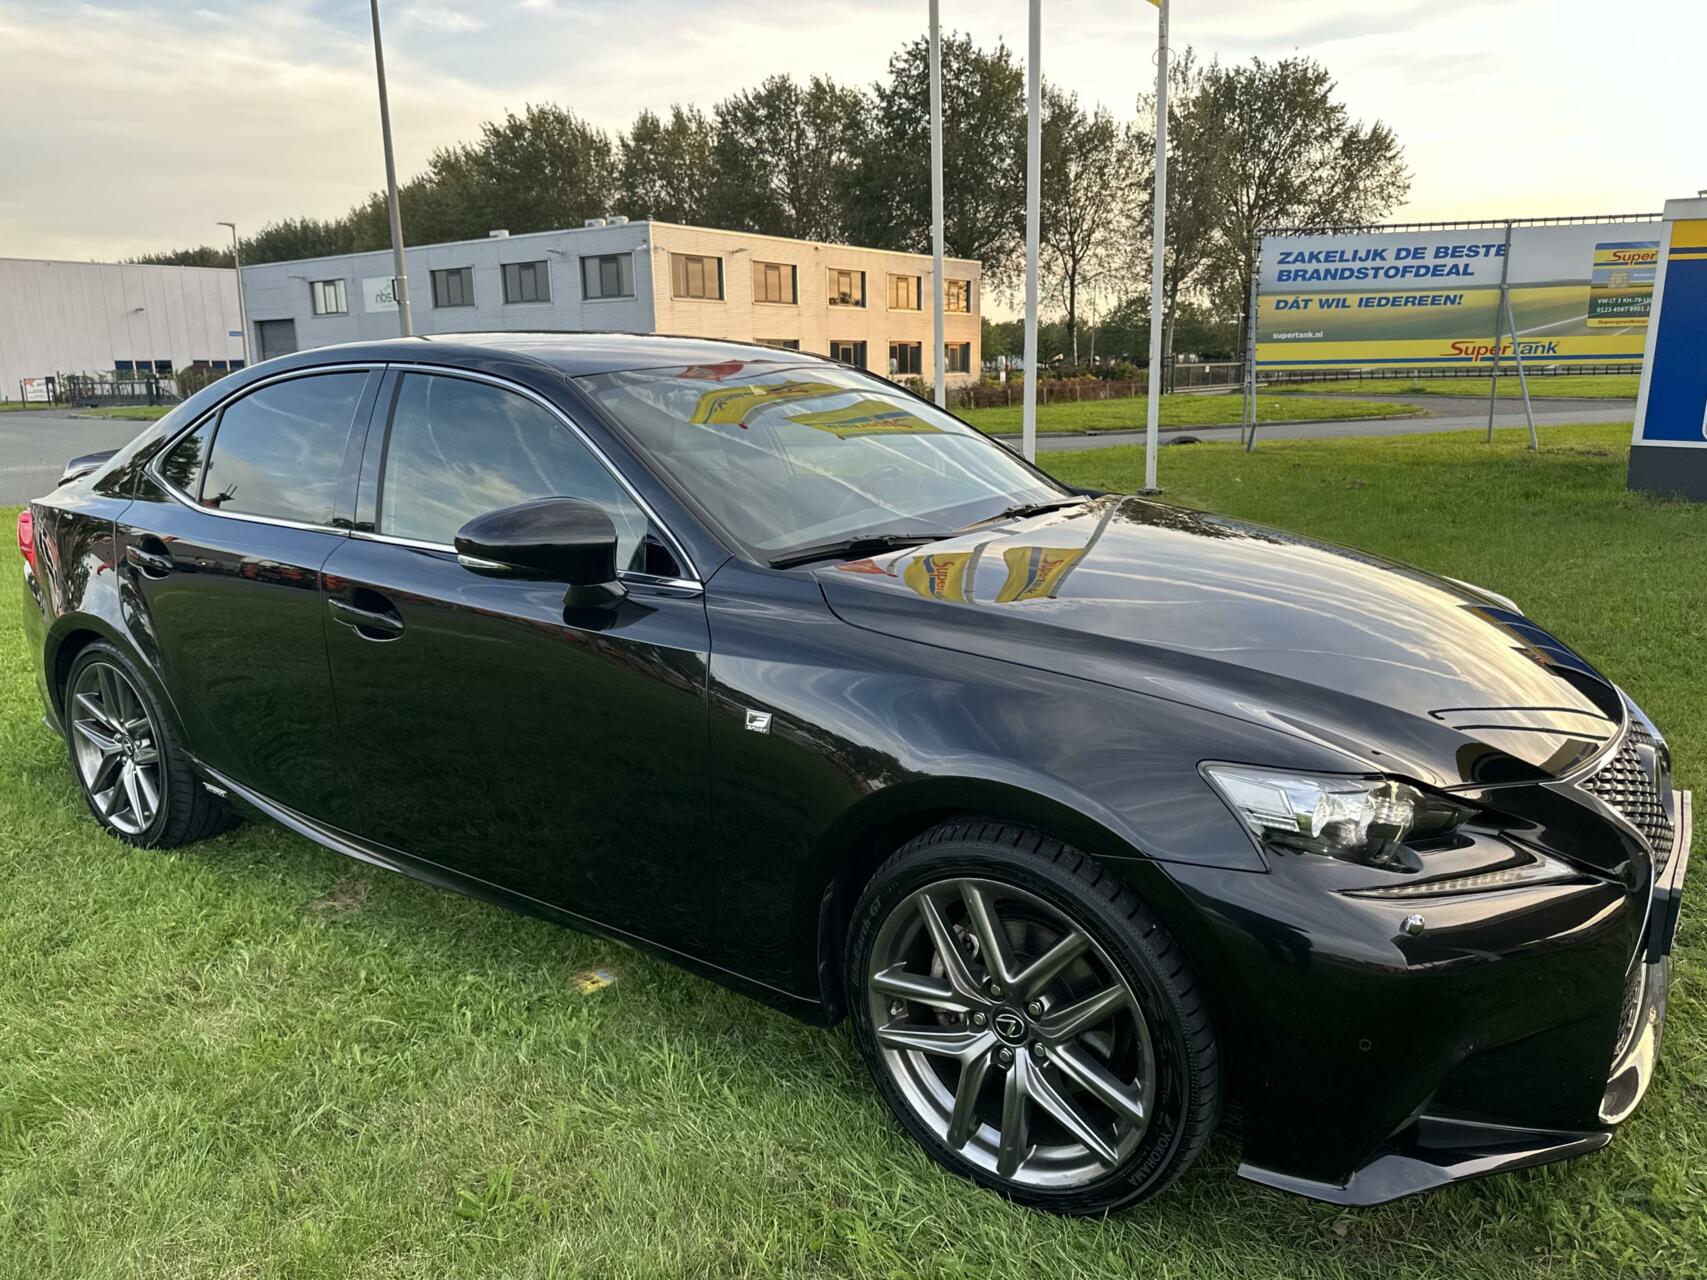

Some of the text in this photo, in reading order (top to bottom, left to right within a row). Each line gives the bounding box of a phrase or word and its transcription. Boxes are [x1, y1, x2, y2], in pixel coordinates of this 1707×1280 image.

[1277, 243, 1510, 264] ZAKELIJK DE BESTE
[1605, 250, 1659, 265] Super
[1277, 263, 1474, 282] BRANDSTOFDEAL
[1275, 294, 1464, 310] DÁT WIL IEDEREEN!
[1273, 331, 1324, 340] supertank.nl
[1127, 1132, 1173, 1187] YOKOHAMA
